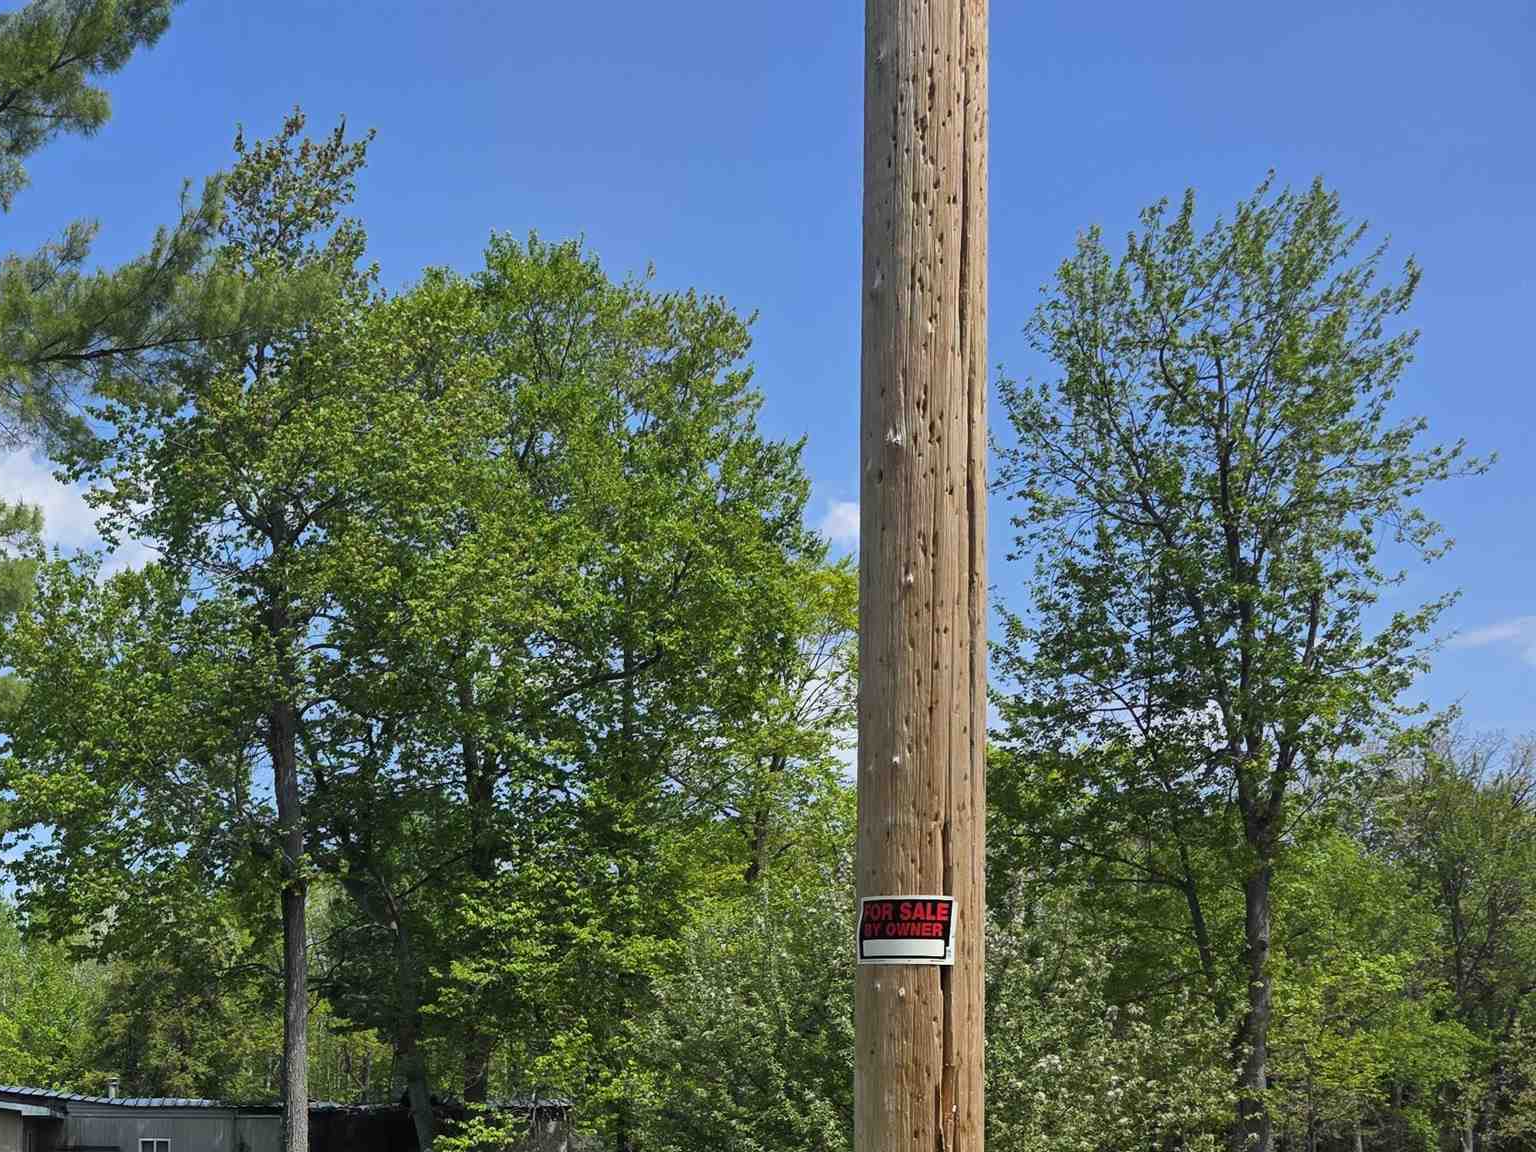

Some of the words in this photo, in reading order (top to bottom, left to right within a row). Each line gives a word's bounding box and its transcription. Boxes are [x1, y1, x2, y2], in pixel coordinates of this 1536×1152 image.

[863, 902, 893, 921] FOR
[899, 902, 950, 921] SALE
[863, 923, 881, 937] BY
[886, 923, 944, 937] OWNER
